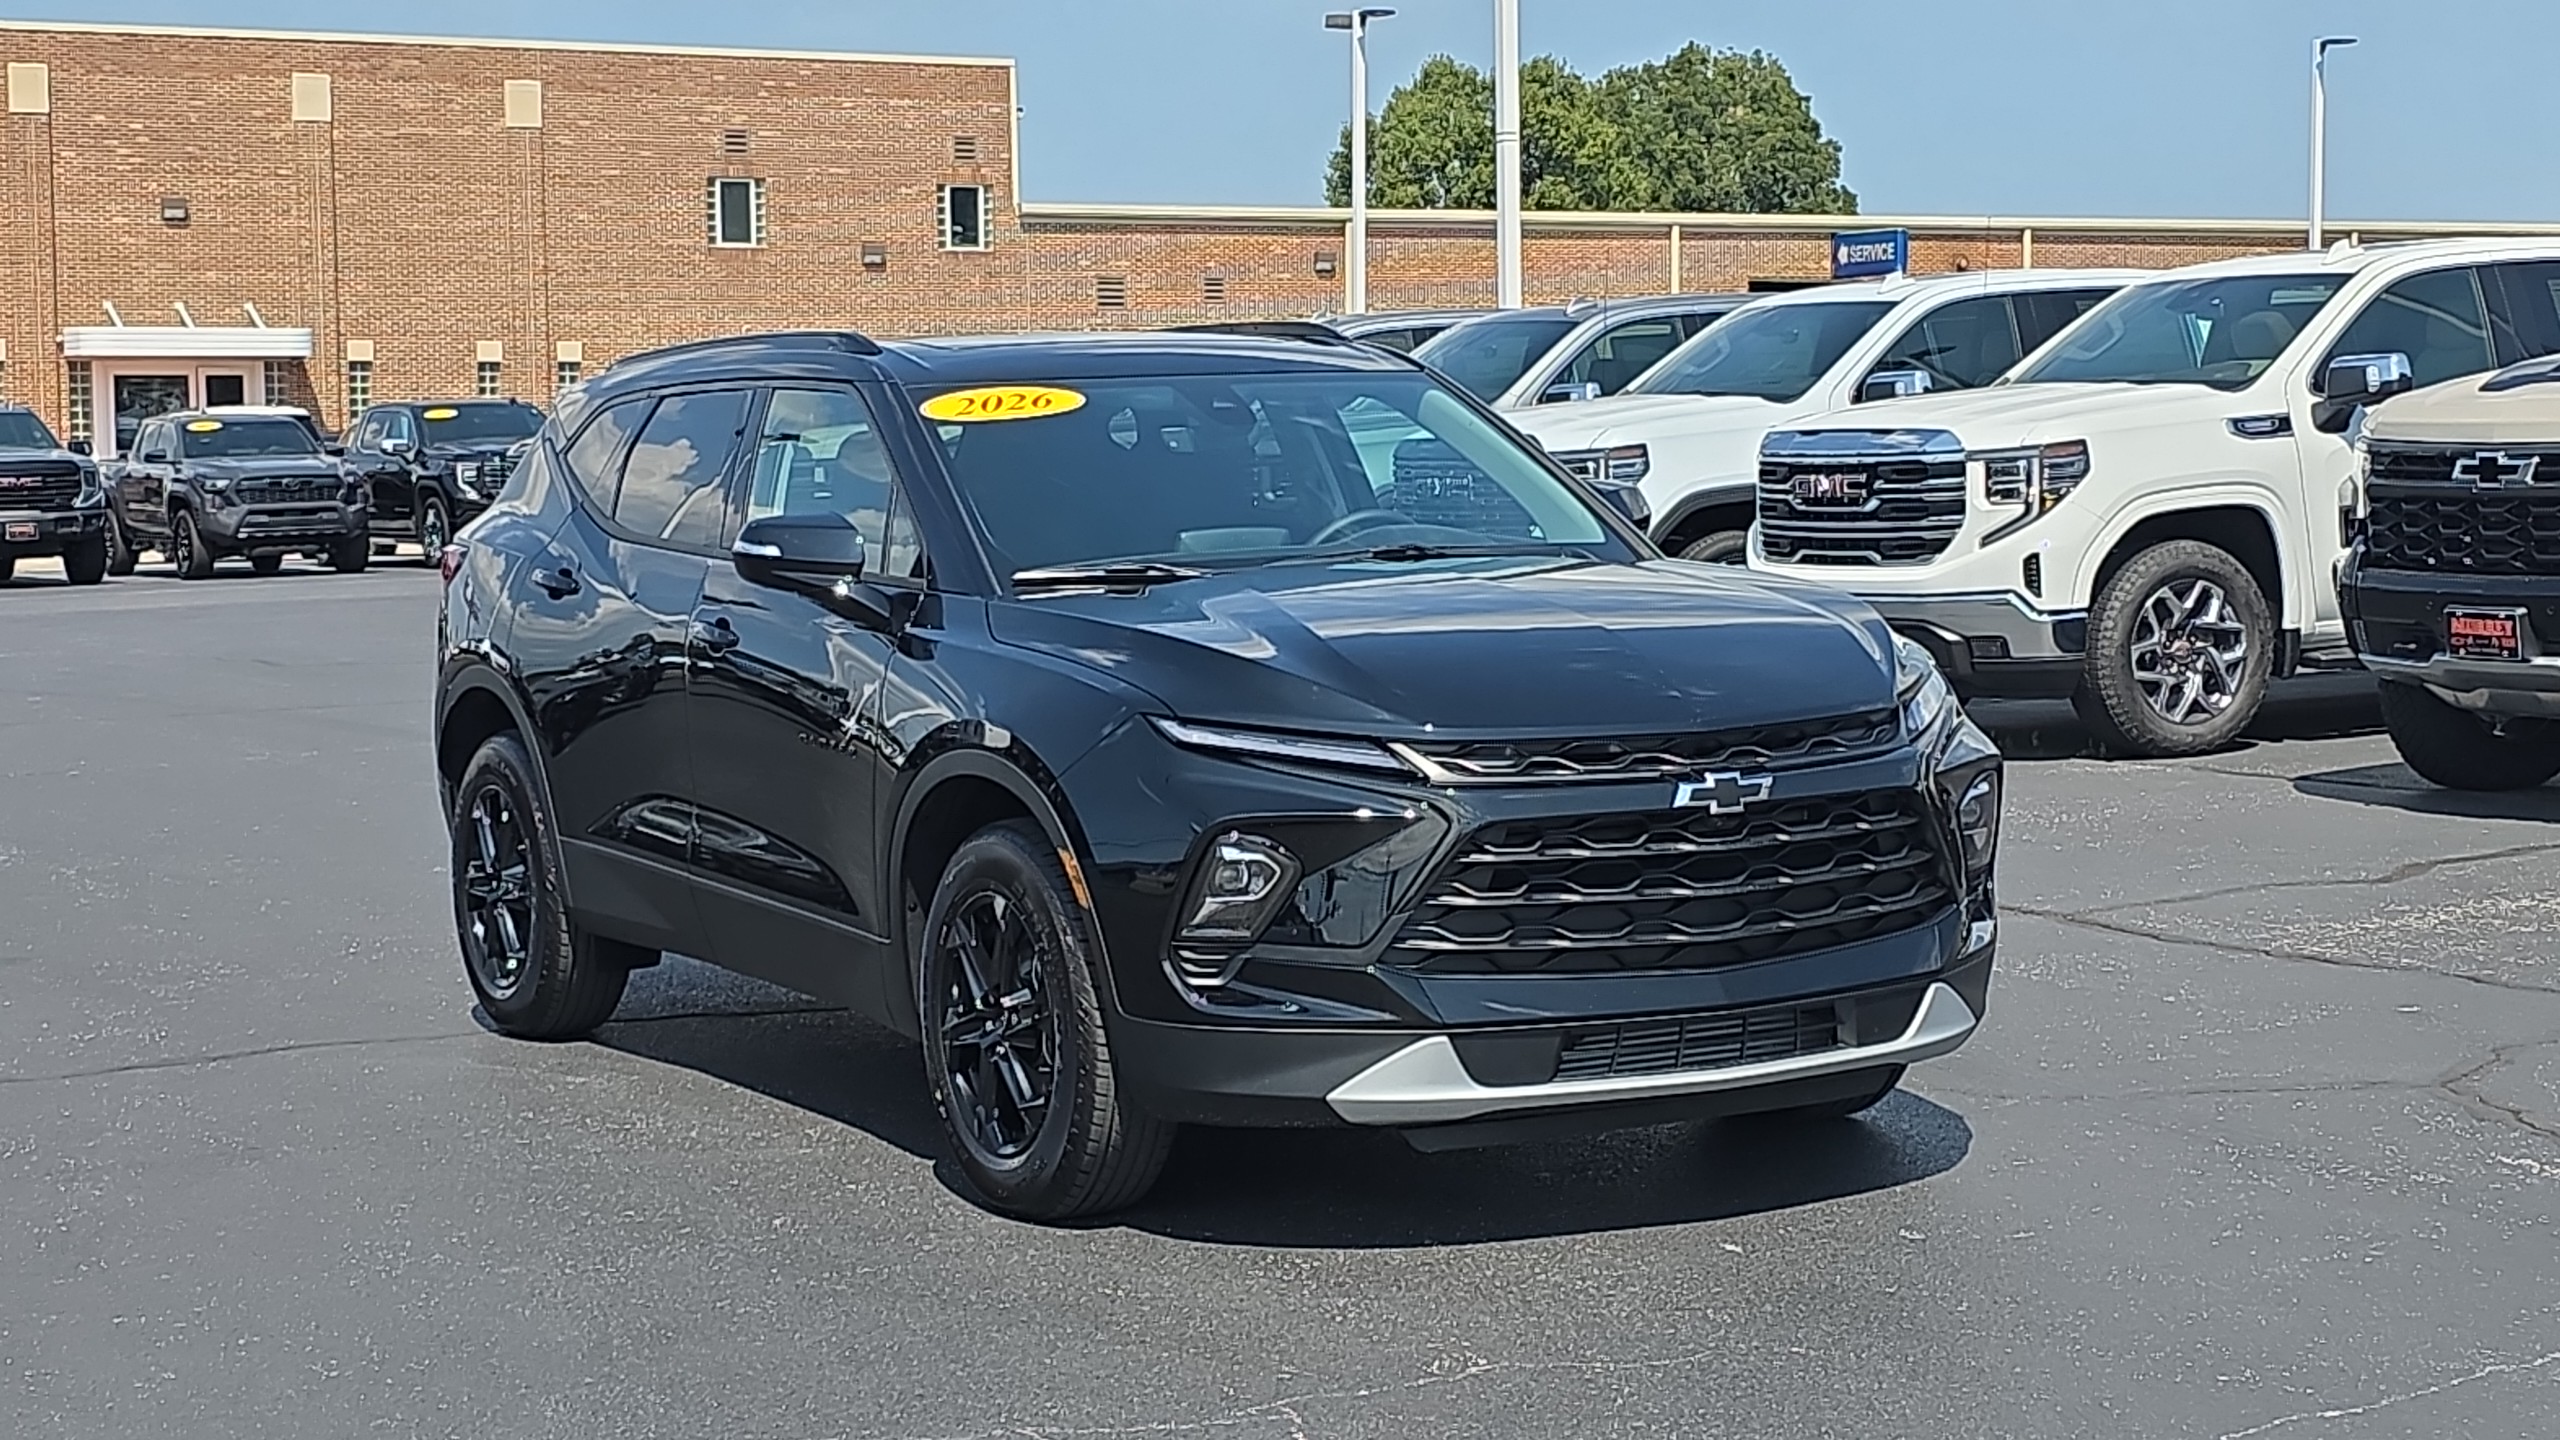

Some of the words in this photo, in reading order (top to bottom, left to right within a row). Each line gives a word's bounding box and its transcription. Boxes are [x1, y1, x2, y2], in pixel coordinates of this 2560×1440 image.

[1850, 242, 1895, 263] SERVICE
[954, 391, 1054, 417] 2026
[1794, 473, 1867, 498] GMC
